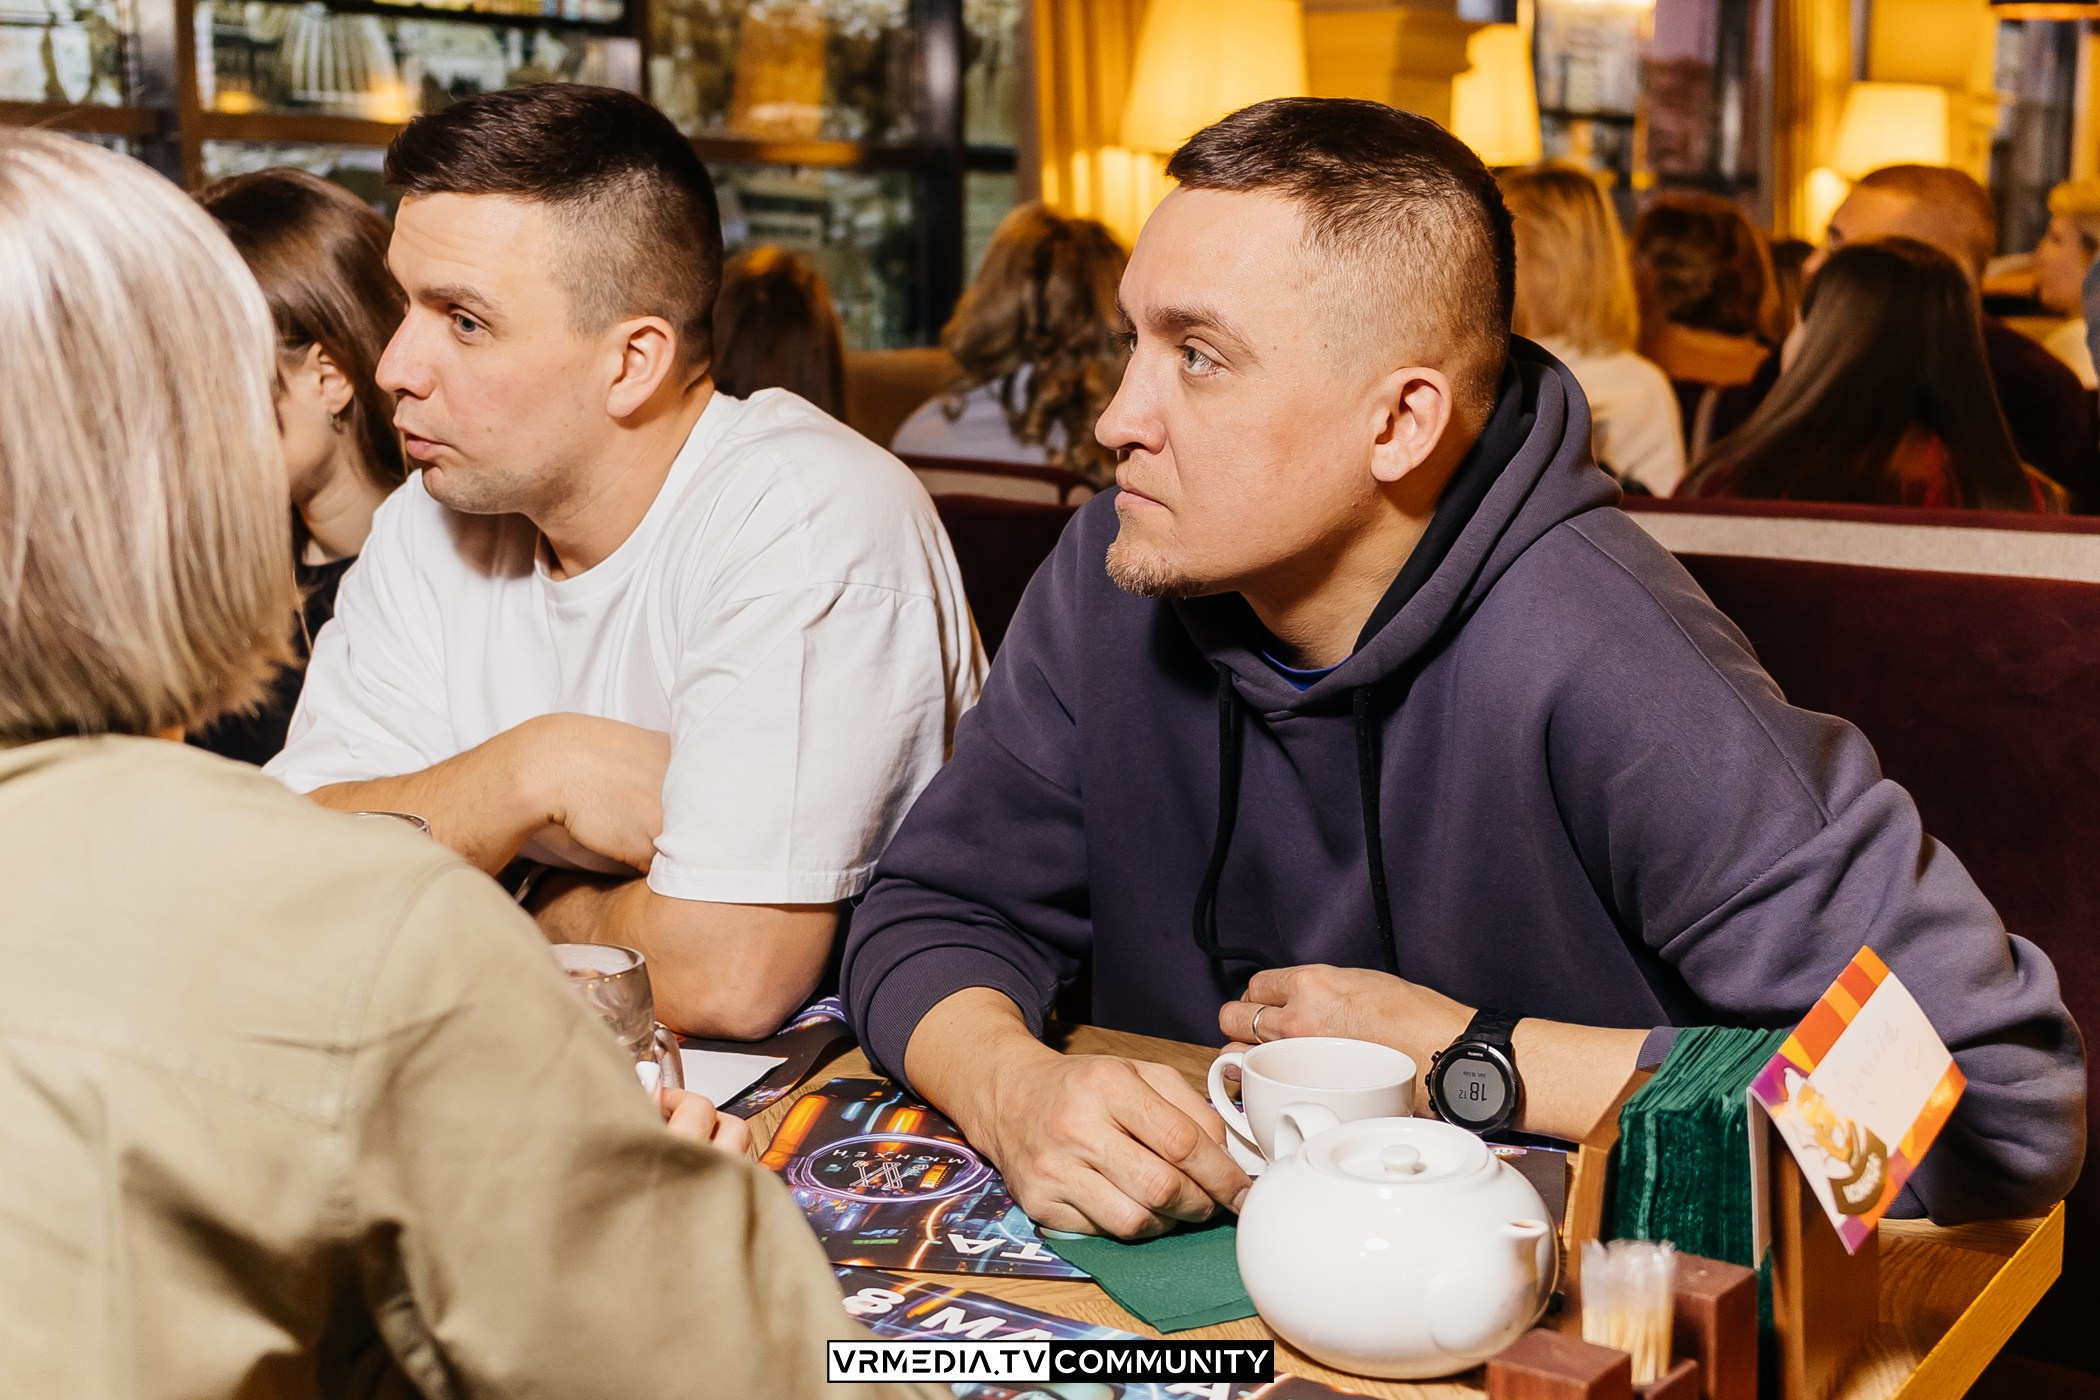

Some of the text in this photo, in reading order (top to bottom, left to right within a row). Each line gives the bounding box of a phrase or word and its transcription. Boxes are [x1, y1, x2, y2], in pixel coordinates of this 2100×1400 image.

[1470, 1082, 1488, 1101] 18
[832, 1149, 966, 1164] МЮНХЕН
[842, 1288, 905, 1314] 8
